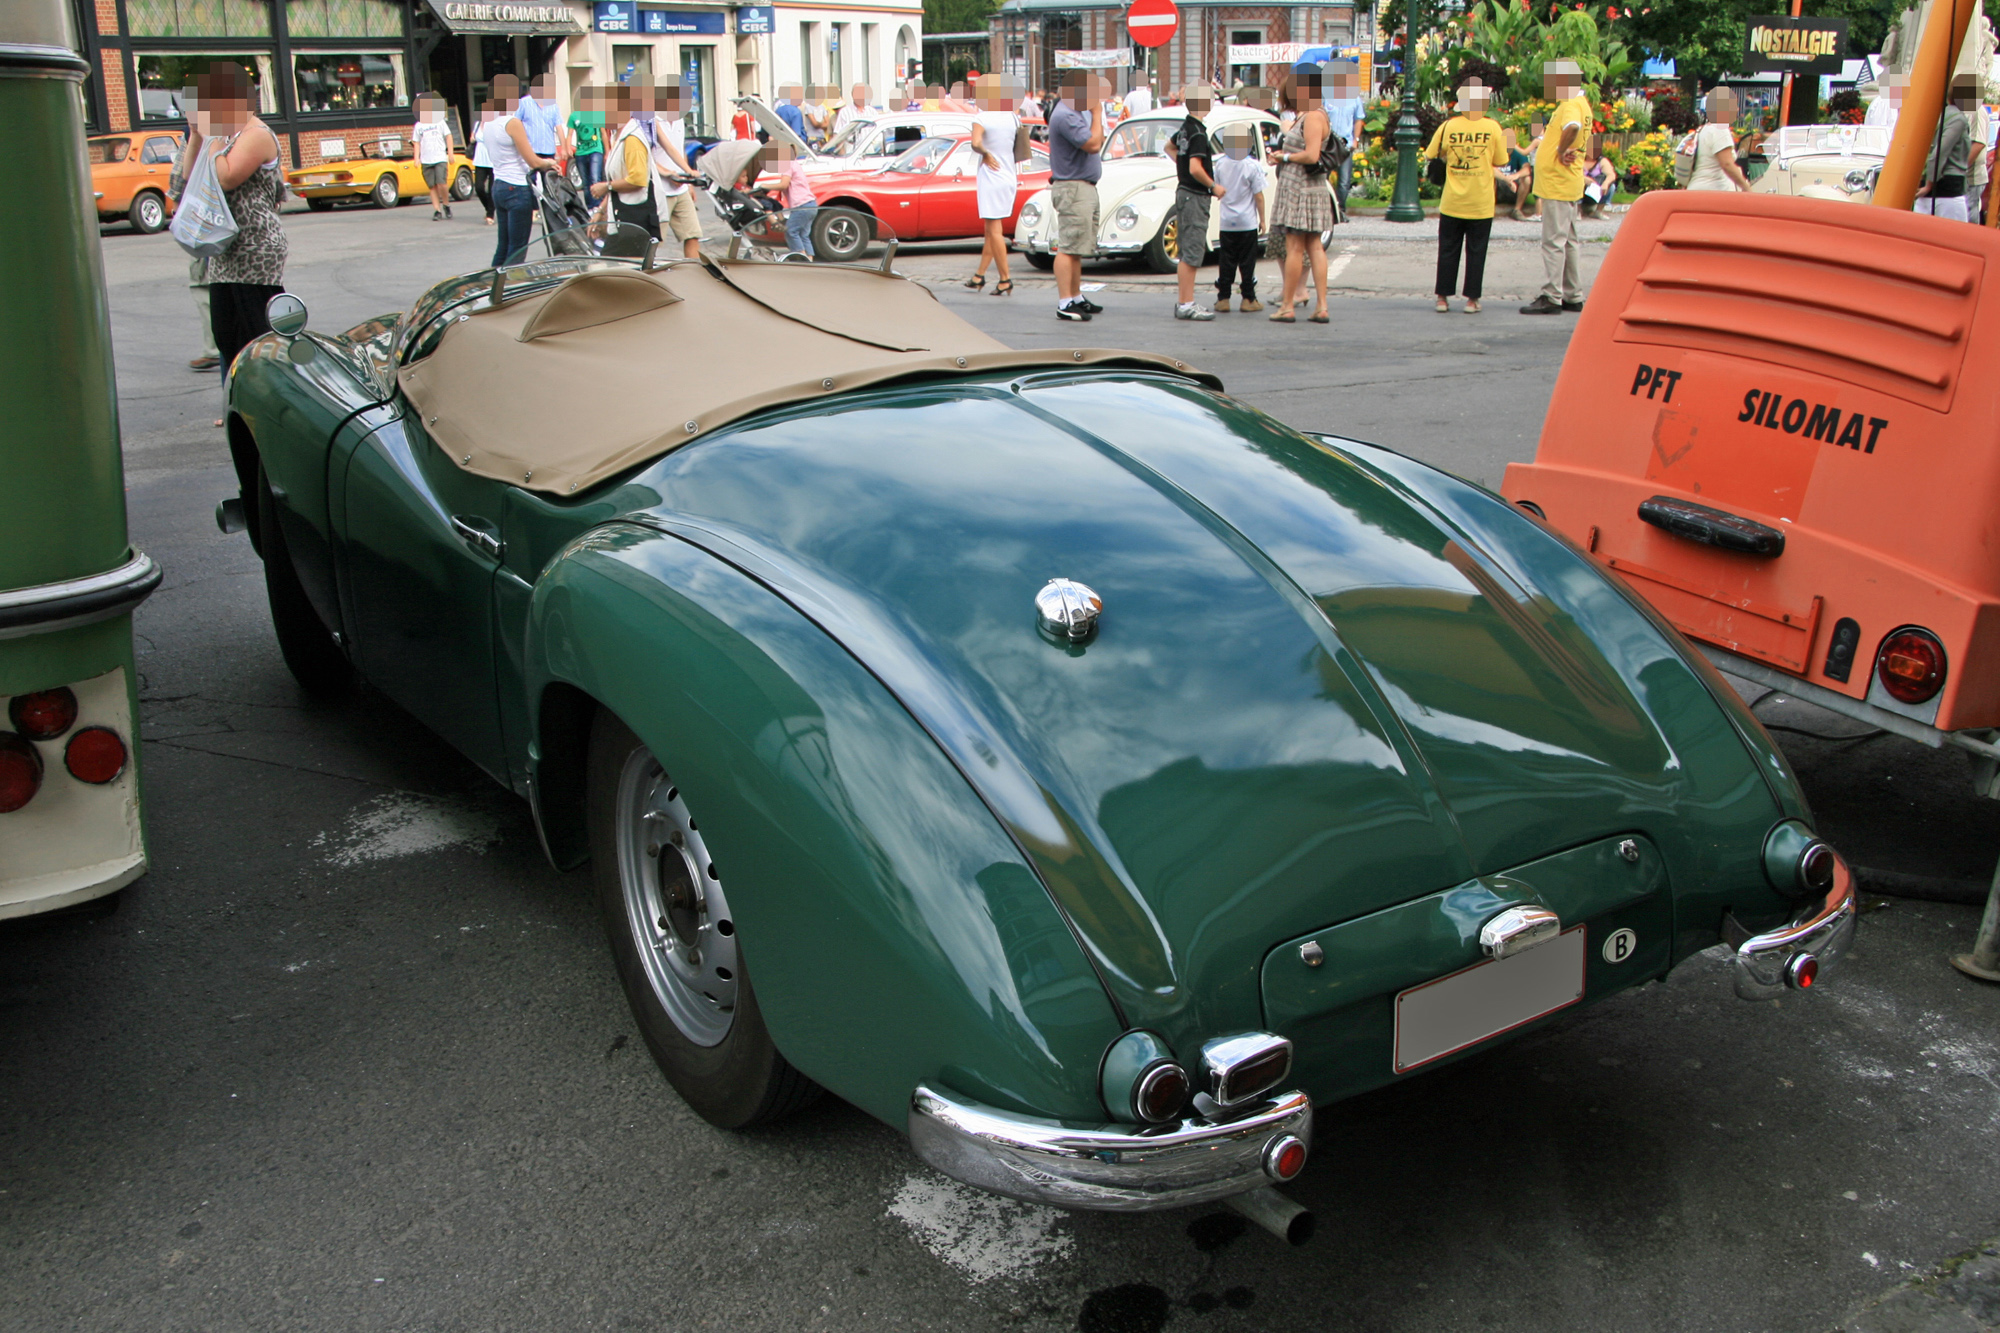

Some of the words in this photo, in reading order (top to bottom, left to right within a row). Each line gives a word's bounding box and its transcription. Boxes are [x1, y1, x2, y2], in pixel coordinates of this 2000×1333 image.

[445, 3, 493, 21] GALERIE
[495, 5, 574, 23] COMMERCIALE
[599, 20, 629, 30] CBC
[741, 23, 768, 32] CBC
[1750, 25, 1838, 55] NOSTALGIE
[1449, 133, 1491, 143] STAFF
[1630, 363, 1683, 404] PFT
[1737, 388, 1889, 455] SILOMAT
[1615, 933, 1628, 960] B
